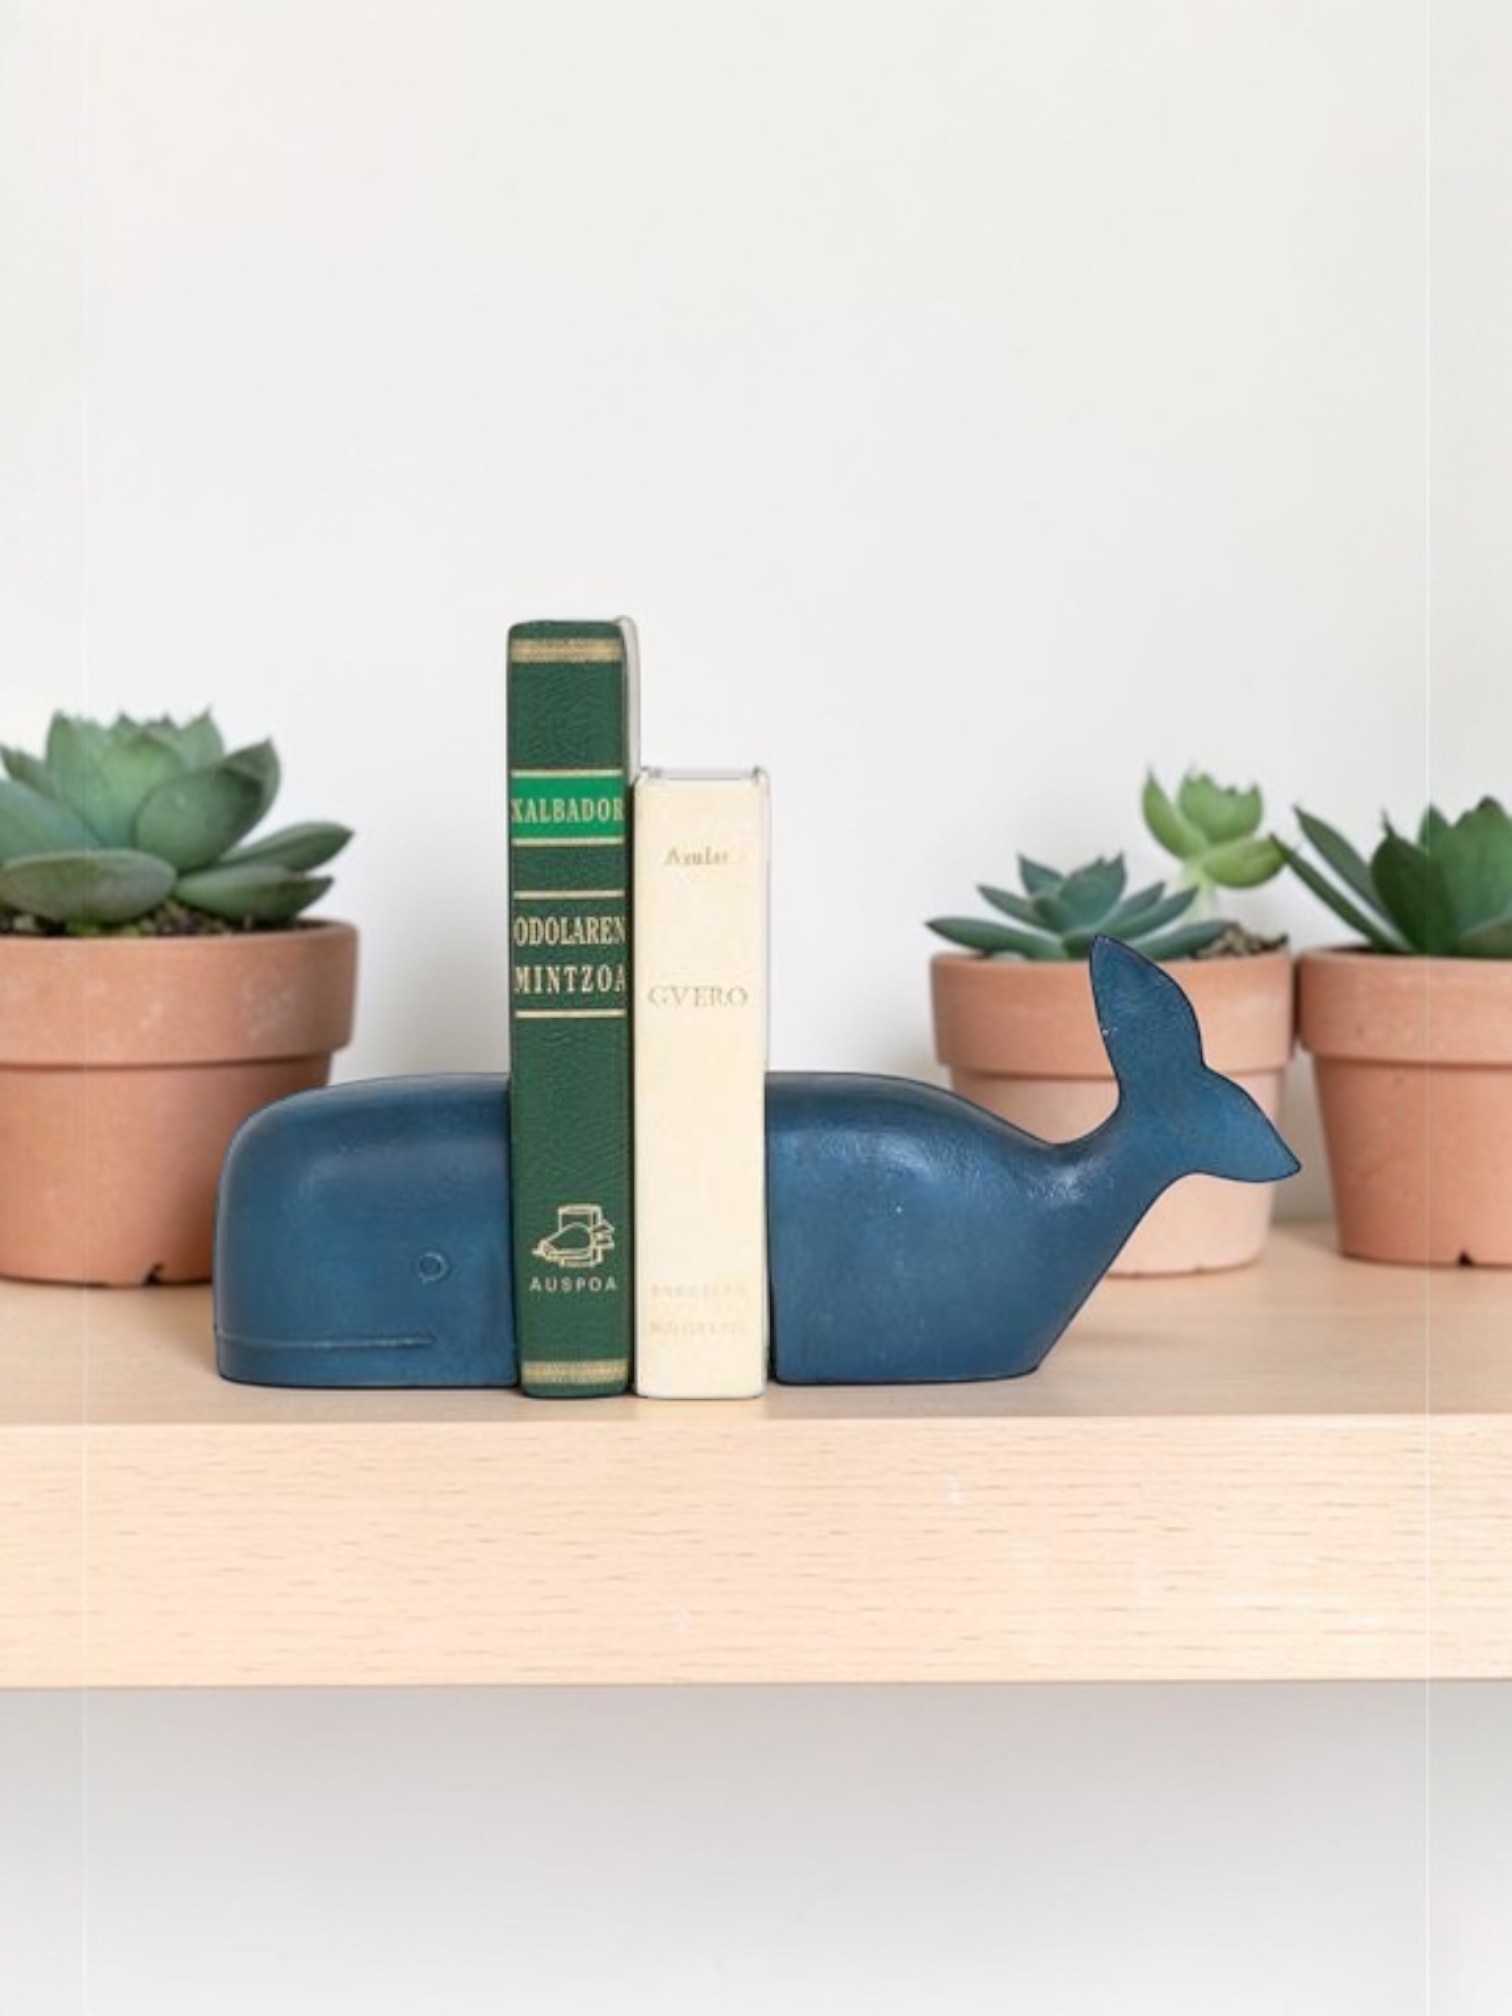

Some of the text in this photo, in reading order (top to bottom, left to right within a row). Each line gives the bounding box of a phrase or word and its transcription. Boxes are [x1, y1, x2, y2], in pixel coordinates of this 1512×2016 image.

[514, 915, 626, 945] ODOLAREN
[514, 963, 626, 994] MINTZOA
[529, 1276, 618, 1293] AUSPOA
